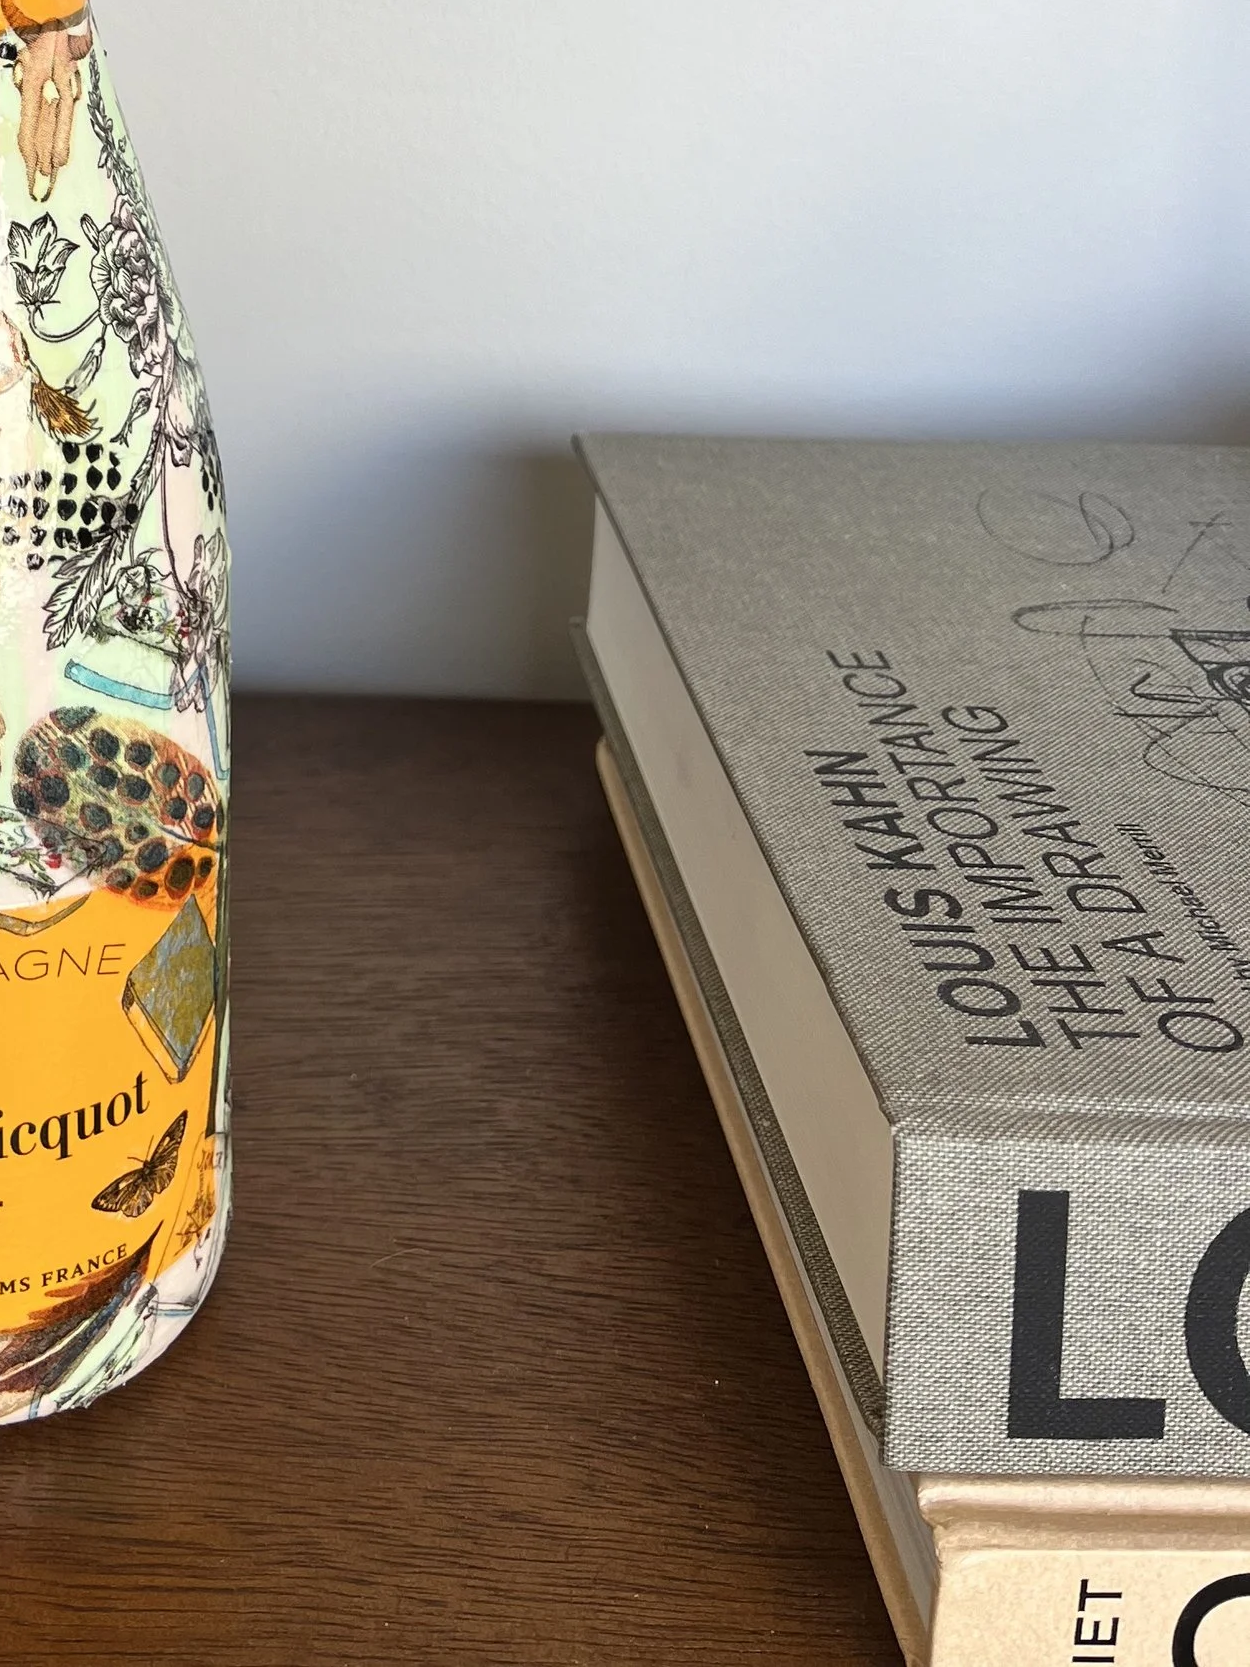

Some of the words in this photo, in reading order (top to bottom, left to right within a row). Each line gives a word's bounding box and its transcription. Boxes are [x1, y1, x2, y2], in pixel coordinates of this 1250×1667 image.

[803, 748, 938, 872] KAHN
[826, 649, 1063, 926] IMPORTANCE
[941, 703, 1150, 915] DRAWING
[1114, 823, 1179, 877] Merrill
[884, 886, 1048, 1049] LOUIS
[1007, 940, 1142, 1050] THE
[1102, 930, 1186, 964] A
[1121, 973, 1245, 1054] OF
[41, 1242, 129, 1289] FRANCE
